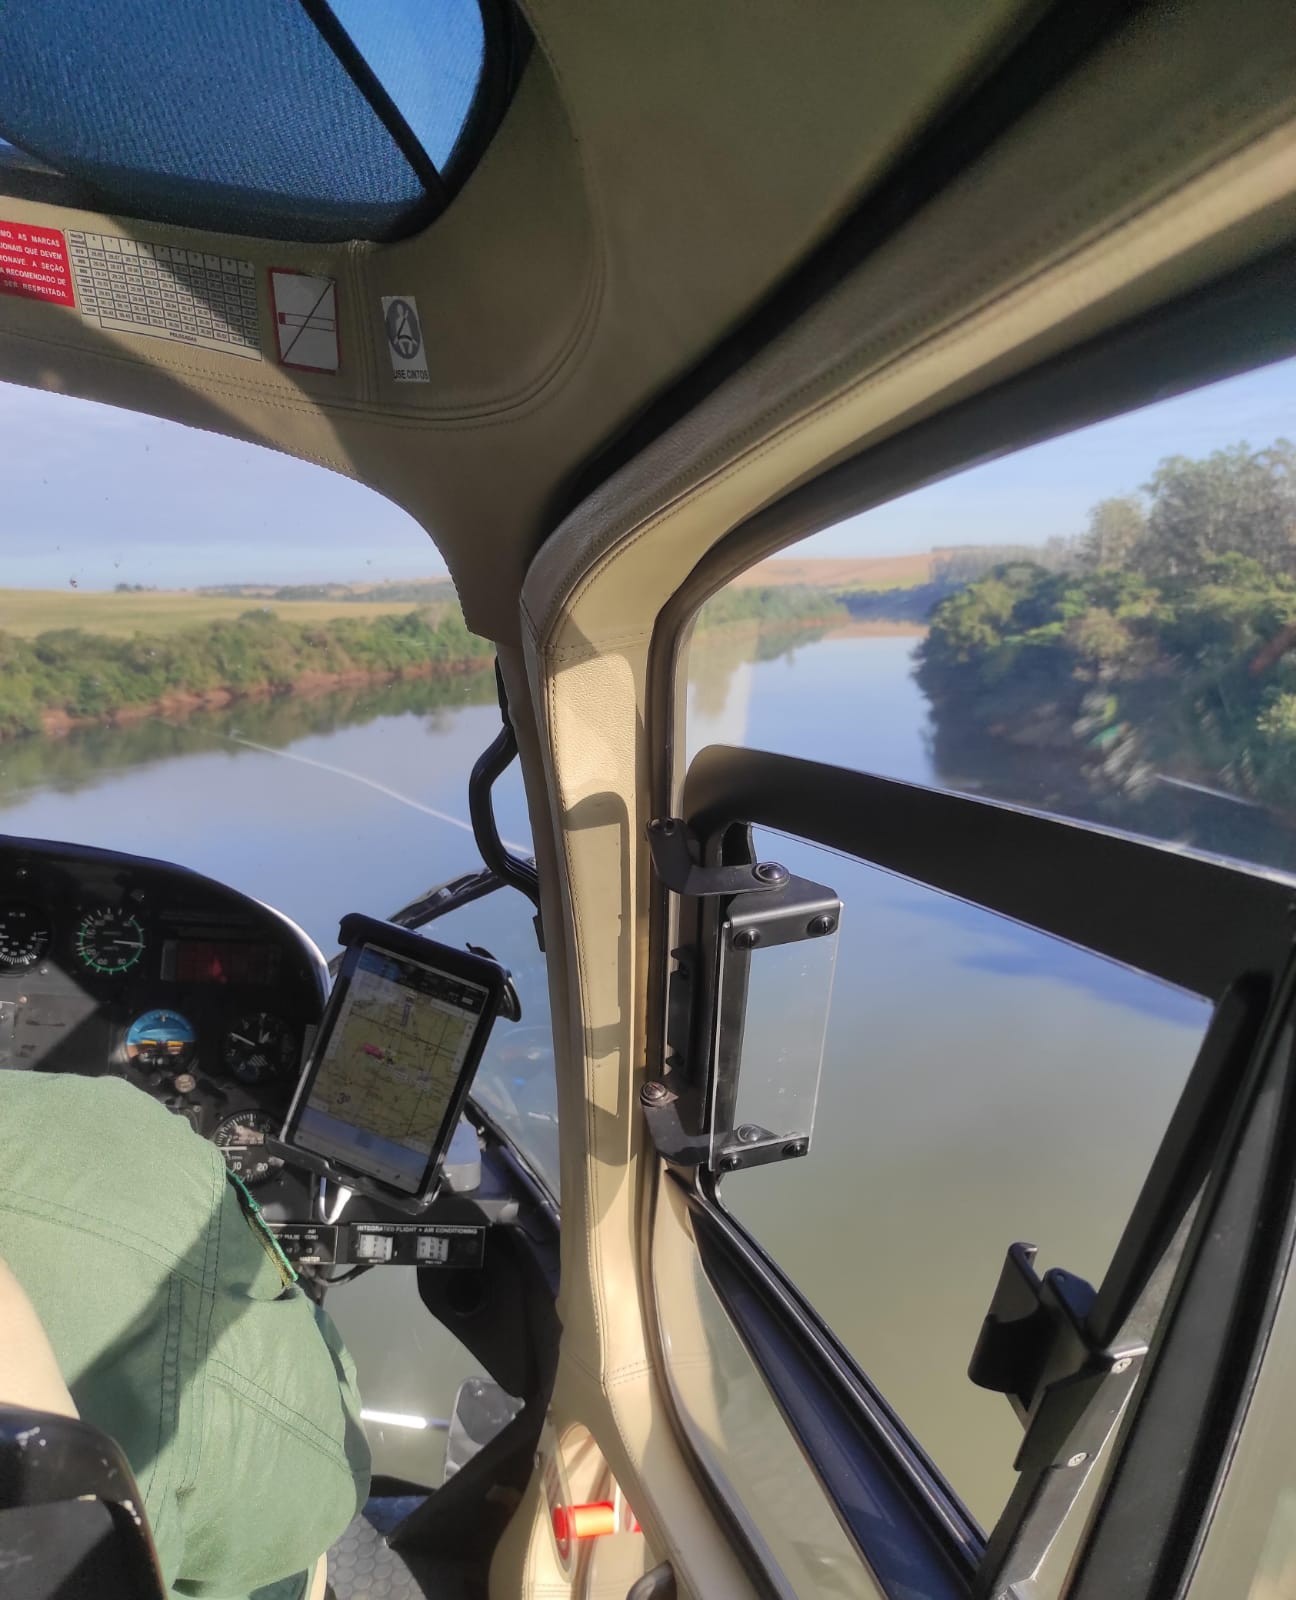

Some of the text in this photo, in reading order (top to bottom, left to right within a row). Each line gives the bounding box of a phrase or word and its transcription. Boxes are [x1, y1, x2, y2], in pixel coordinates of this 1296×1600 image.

[18, 232, 27, 241] AS
[31, 235, 60, 248] MARCAS
[24, 246, 38, 256] QUE
[40, 249, 63, 261] DEVEM
[32, 260, 37, 268] A
[41, 262, 65, 274] SEÇÃO
[6, 268, 56, 284] RECOMENDADO
[57, 277, 66, 286] DE
[392, 368, 429, 380] USE CINTOS
[233, 1161, 242, 1171] 10
[256, 1162, 269, 1172] 20
[356, 1225, 395, 1233] INTEGRATED
